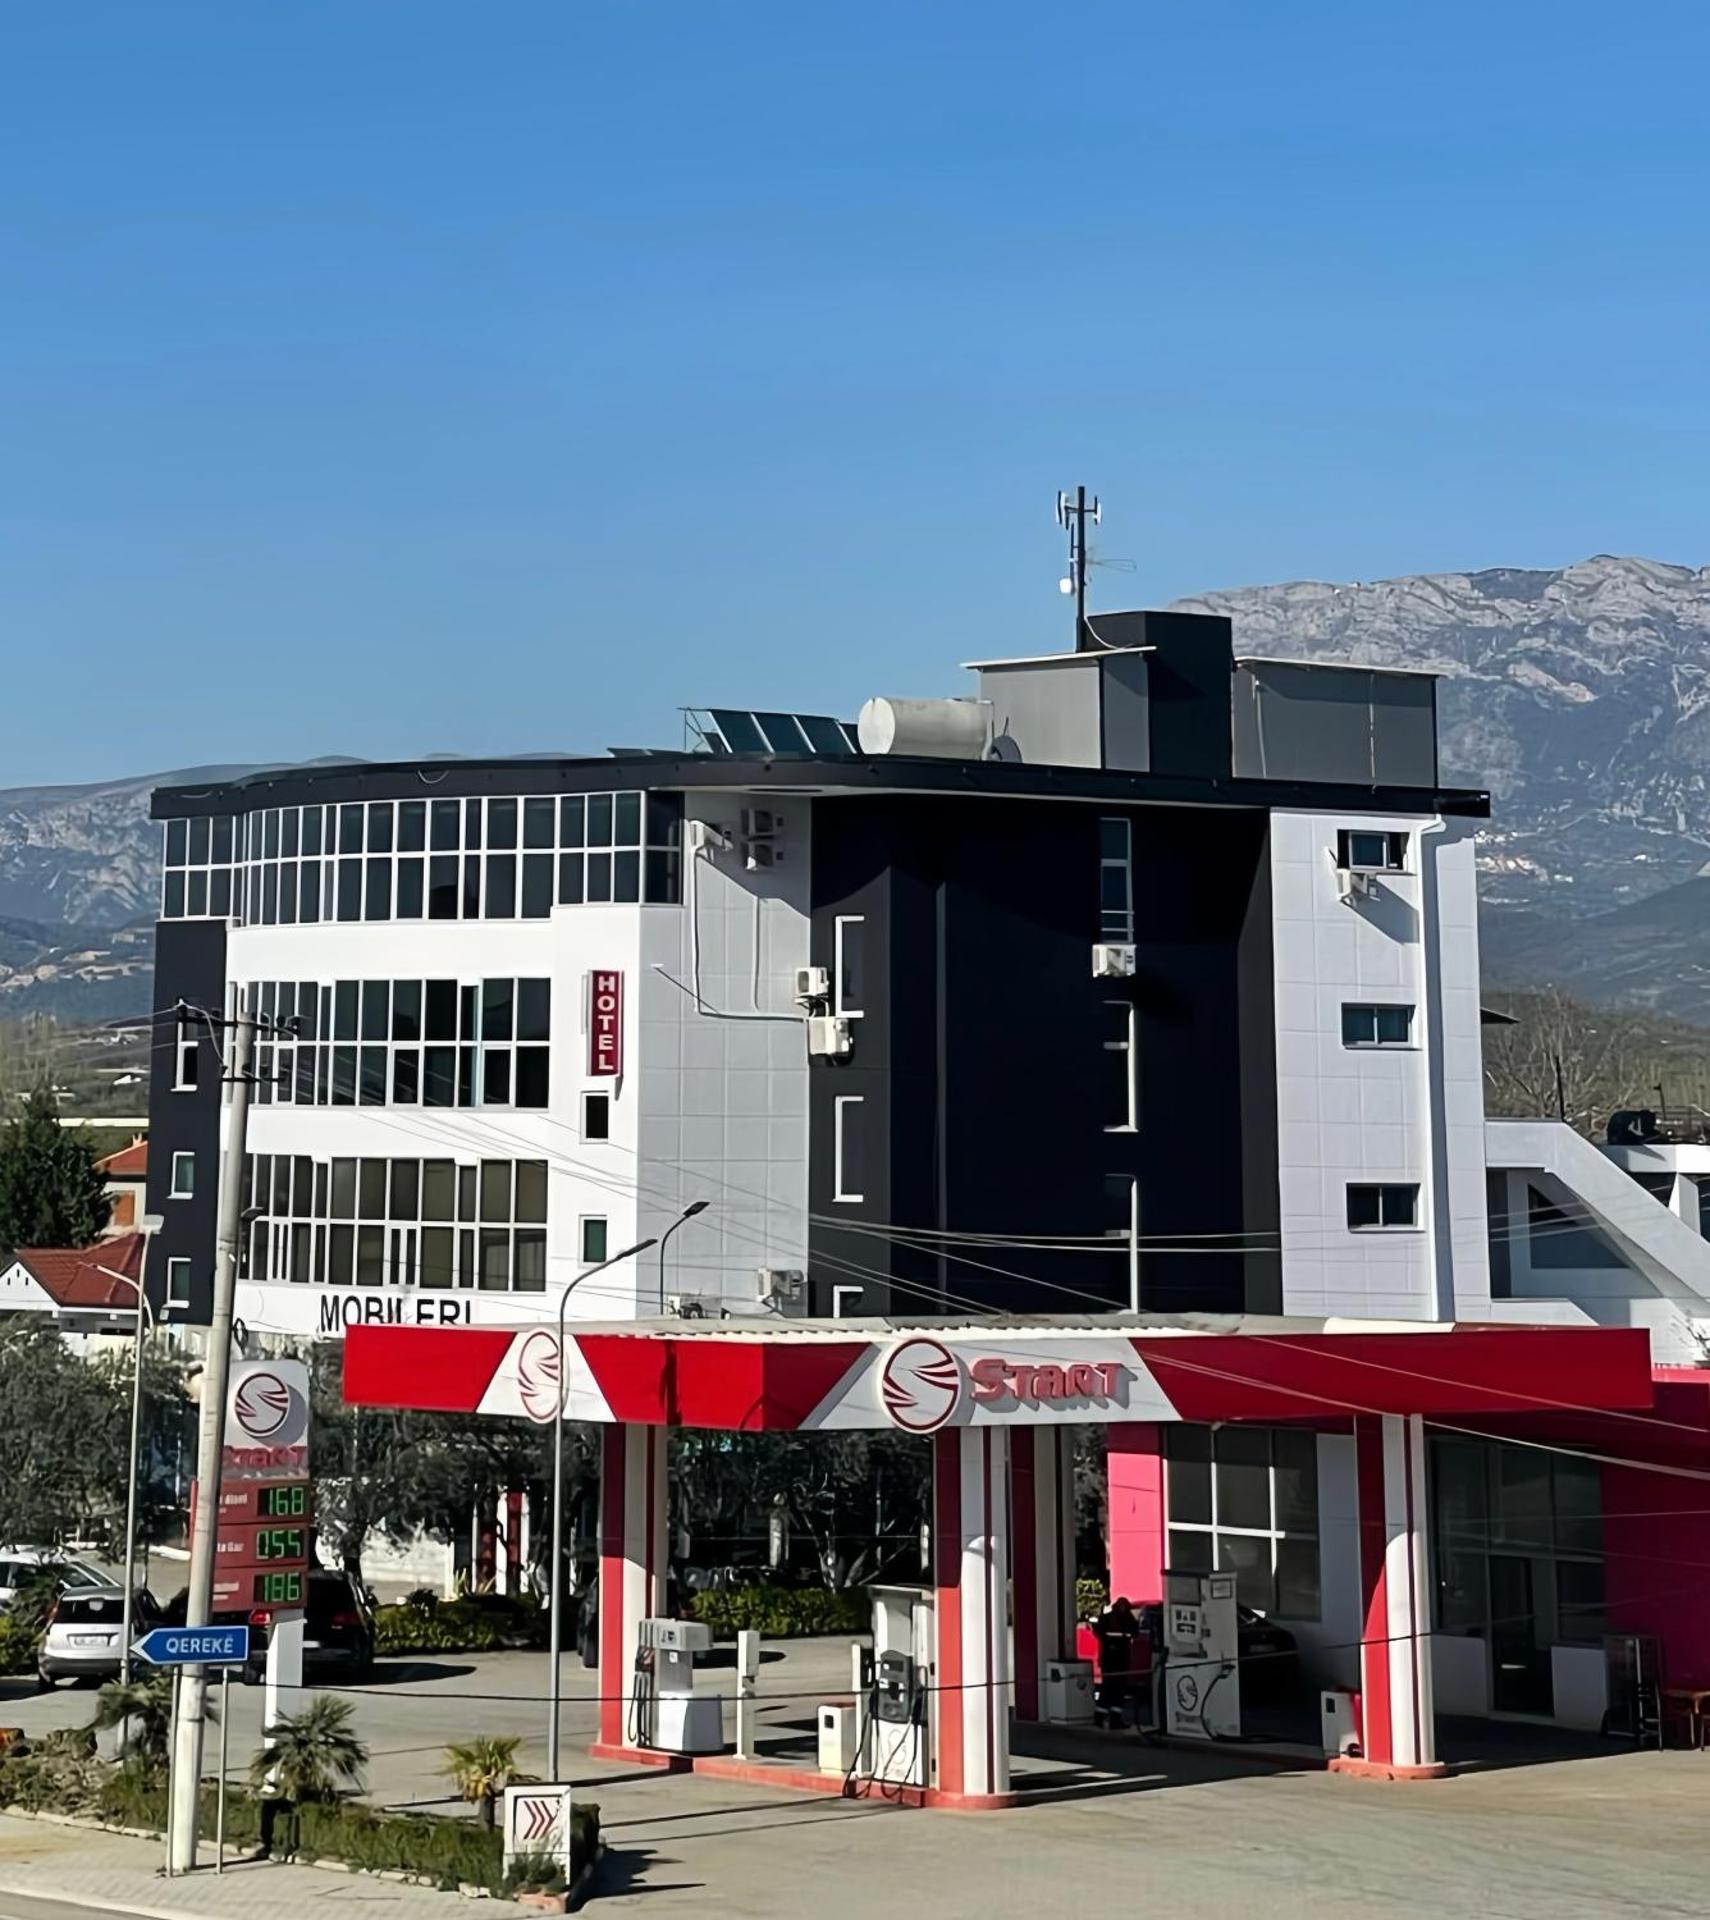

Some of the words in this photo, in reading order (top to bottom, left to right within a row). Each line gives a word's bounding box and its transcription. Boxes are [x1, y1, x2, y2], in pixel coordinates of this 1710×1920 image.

[597, 975, 616, 1070] HOTEL
[269, 1487, 304, 1516] 168
[264, 1572, 300, 1602] 186
[165, 1634, 234, 1654] QEREKË
